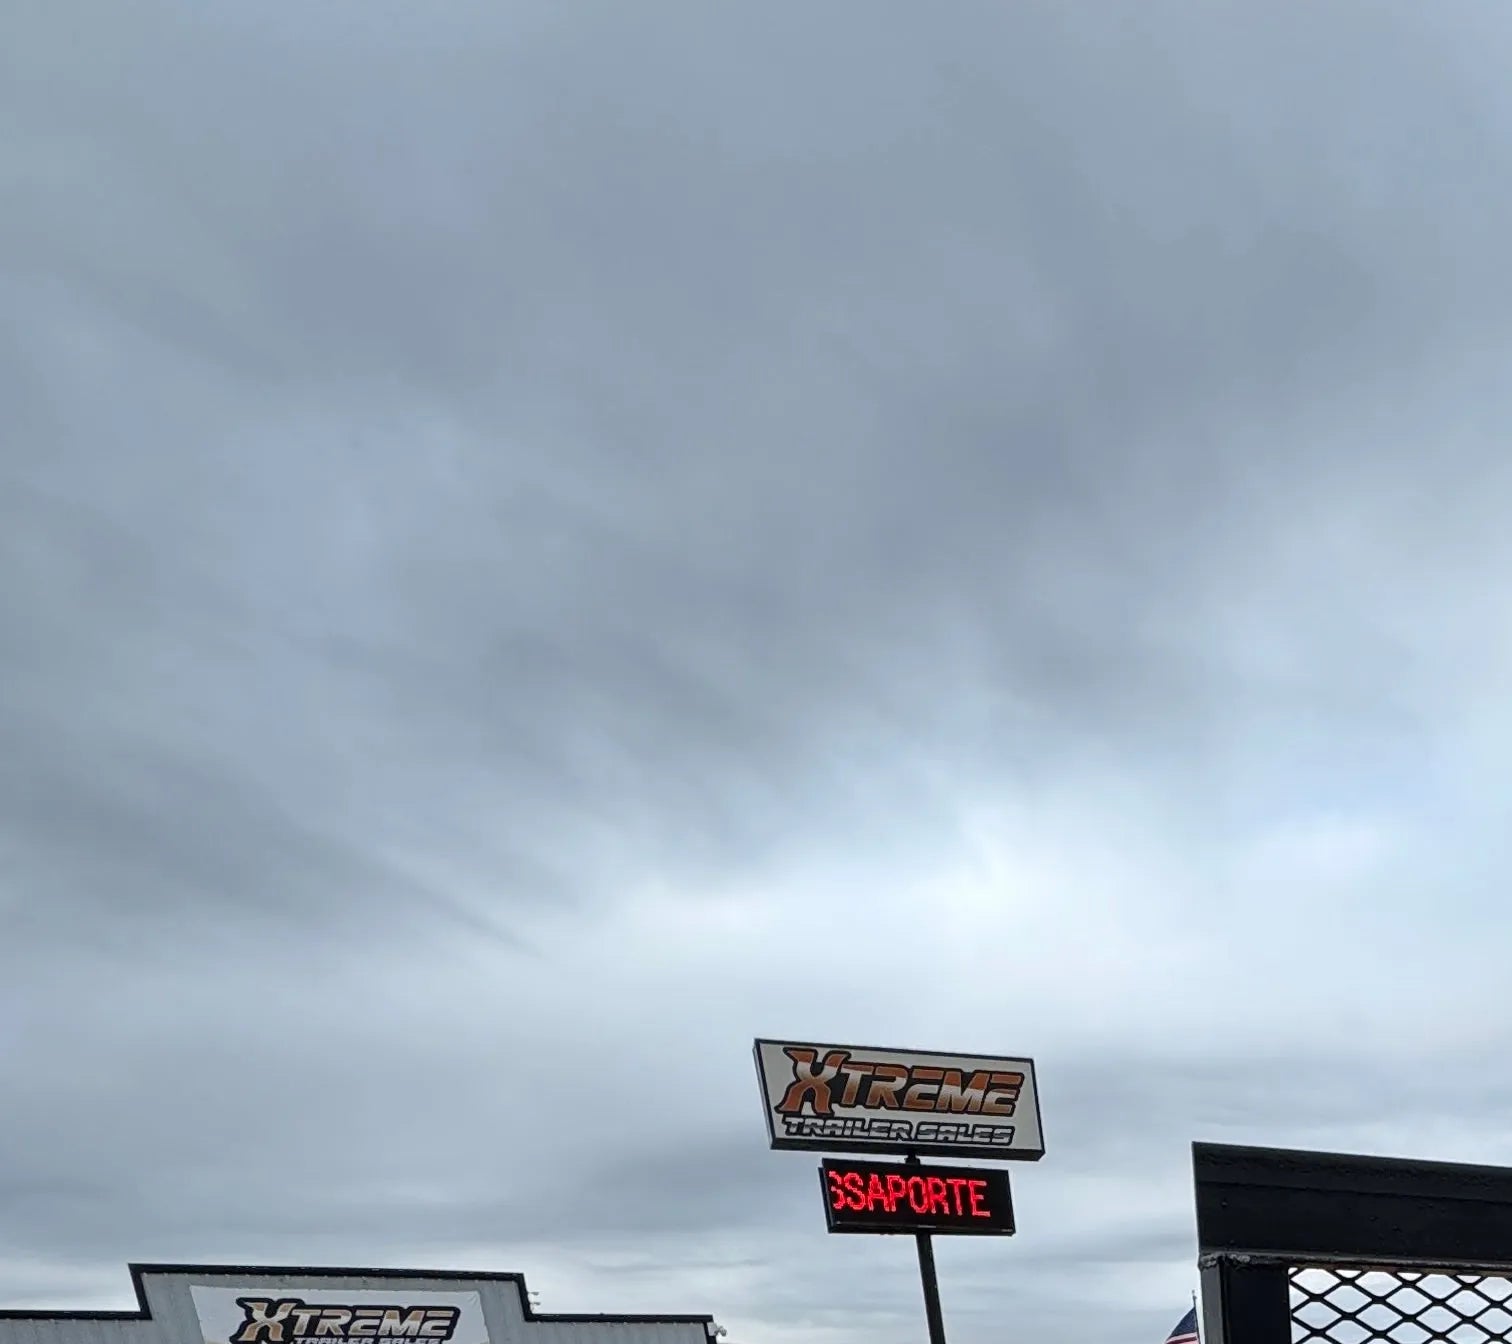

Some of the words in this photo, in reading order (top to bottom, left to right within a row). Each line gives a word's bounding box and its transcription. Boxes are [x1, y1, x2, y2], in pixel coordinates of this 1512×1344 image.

[775, 1047, 1024, 1116] XTREME
[783, 1117, 913, 1142] TRAILER
[914, 1123, 1015, 1145] SALES
[231, 1299, 459, 1344] XTREME
